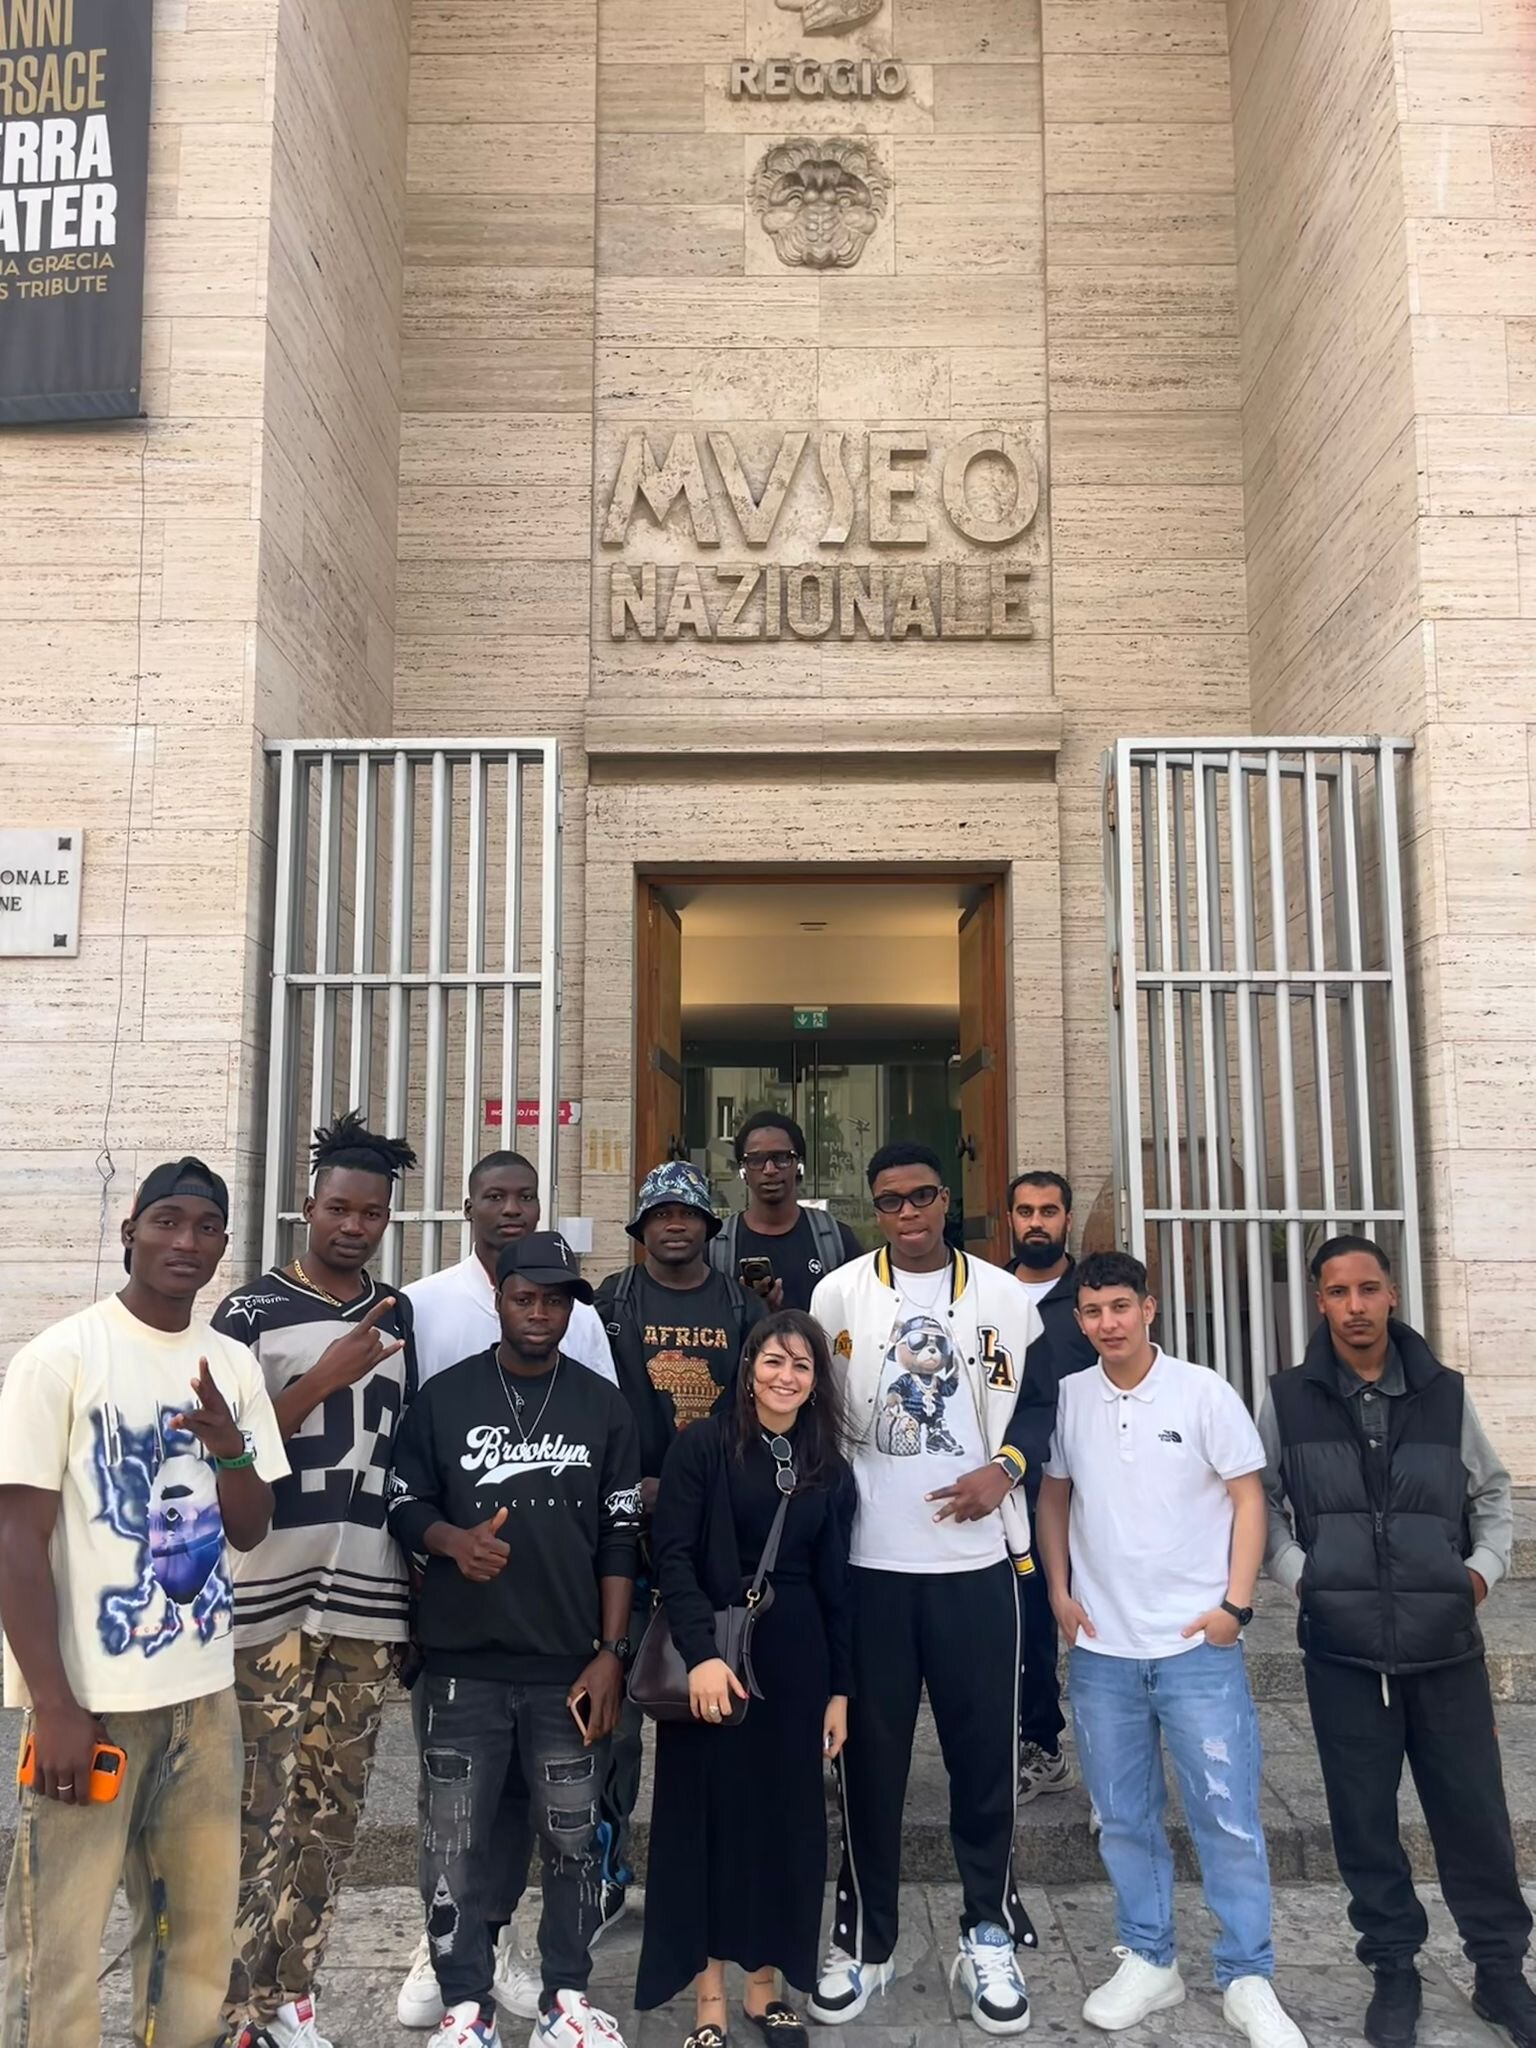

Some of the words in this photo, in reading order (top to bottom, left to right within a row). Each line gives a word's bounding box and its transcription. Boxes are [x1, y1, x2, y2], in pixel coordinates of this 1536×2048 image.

[729, 58, 908, 102] REGGIO
[0, 114, 113, 184] RRA
[27, 252, 115, 275] GRÆCIA
[16, 275, 108, 299] TRIBUTE
[610, 561, 1034, 642] NAZIONALE
[0, 870, 70, 886] ONALE
[460, 1425, 592, 1477] Brooklyn
